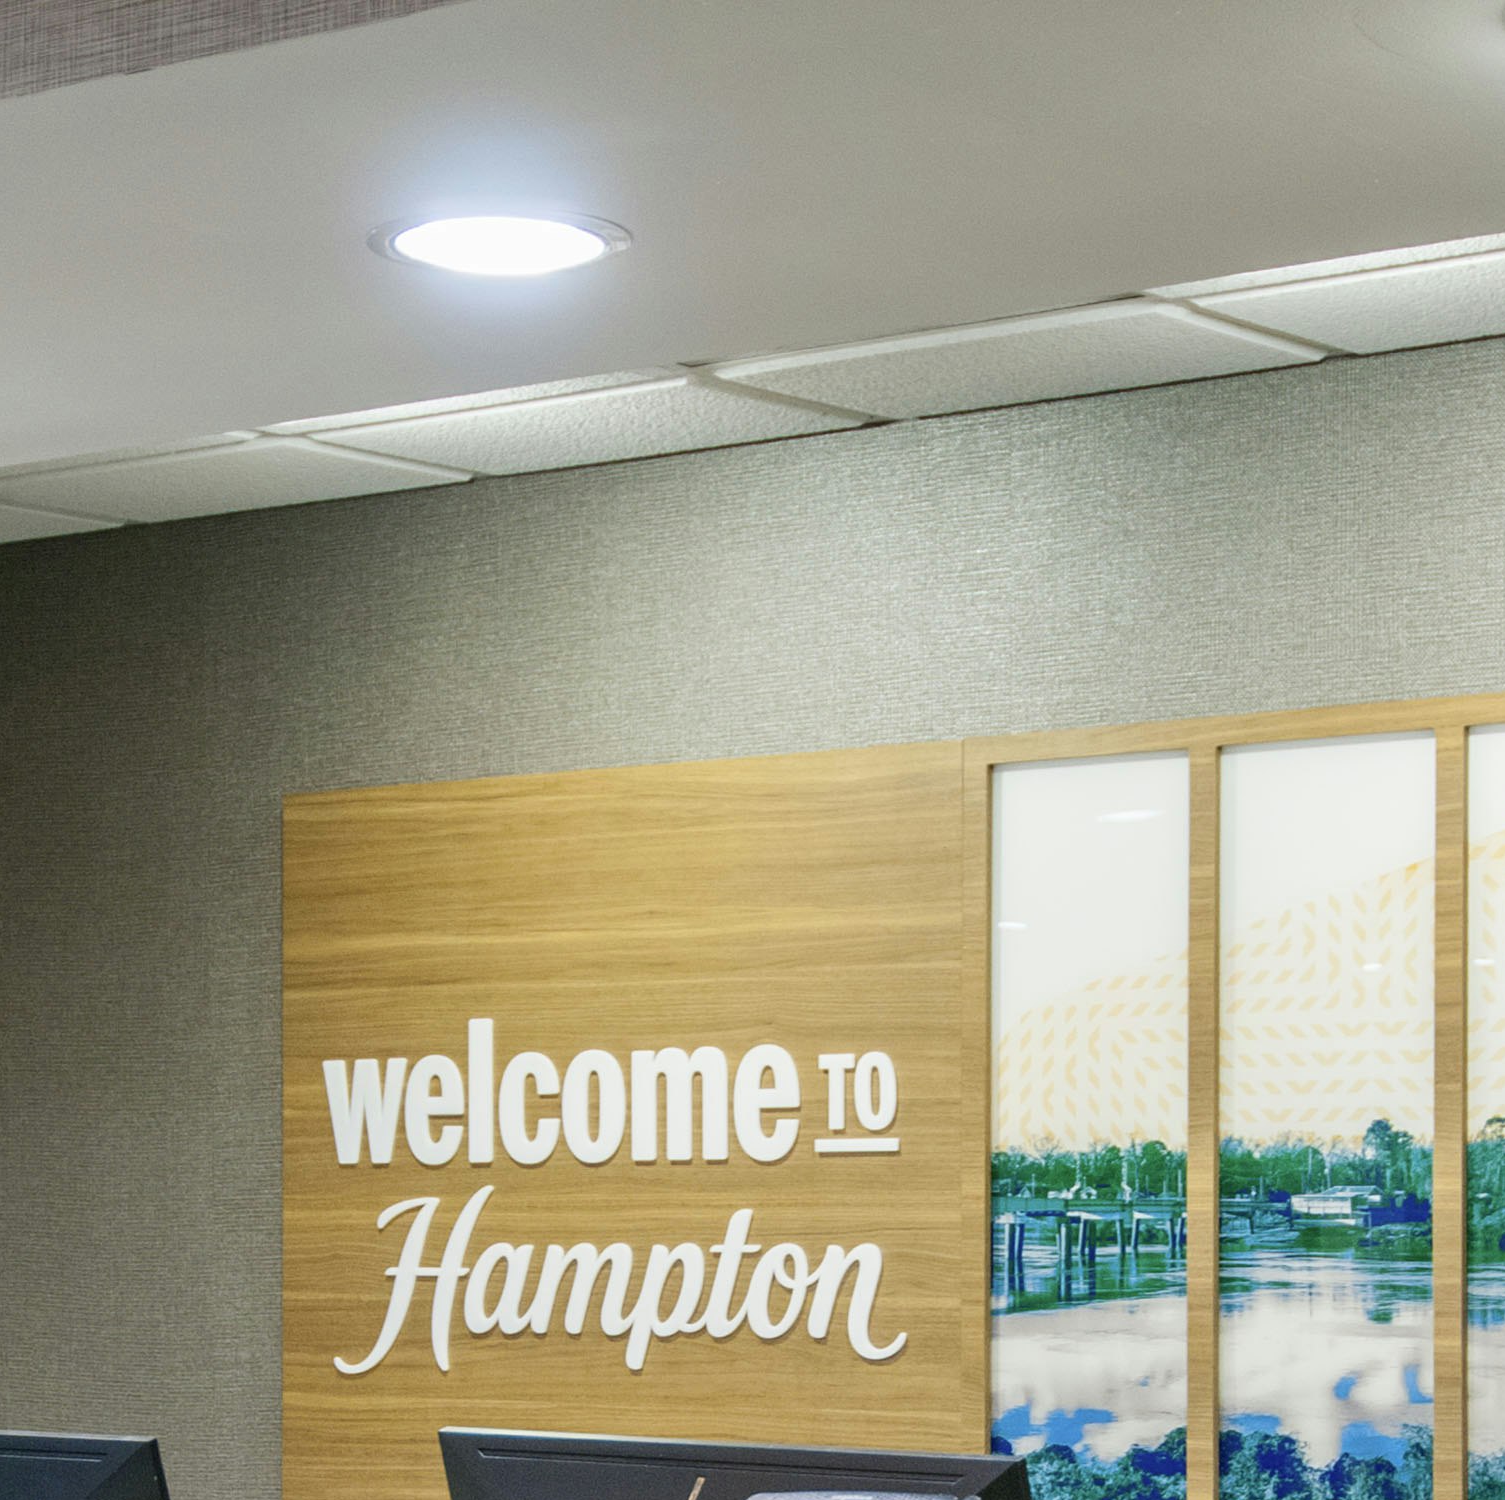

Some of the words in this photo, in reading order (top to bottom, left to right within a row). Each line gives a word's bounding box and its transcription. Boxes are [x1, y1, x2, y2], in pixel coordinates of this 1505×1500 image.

[322, 1018, 801, 1166] welcome
[817, 1050, 899, 1132] TO
[332, 1184, 908, 1375] Hampton
